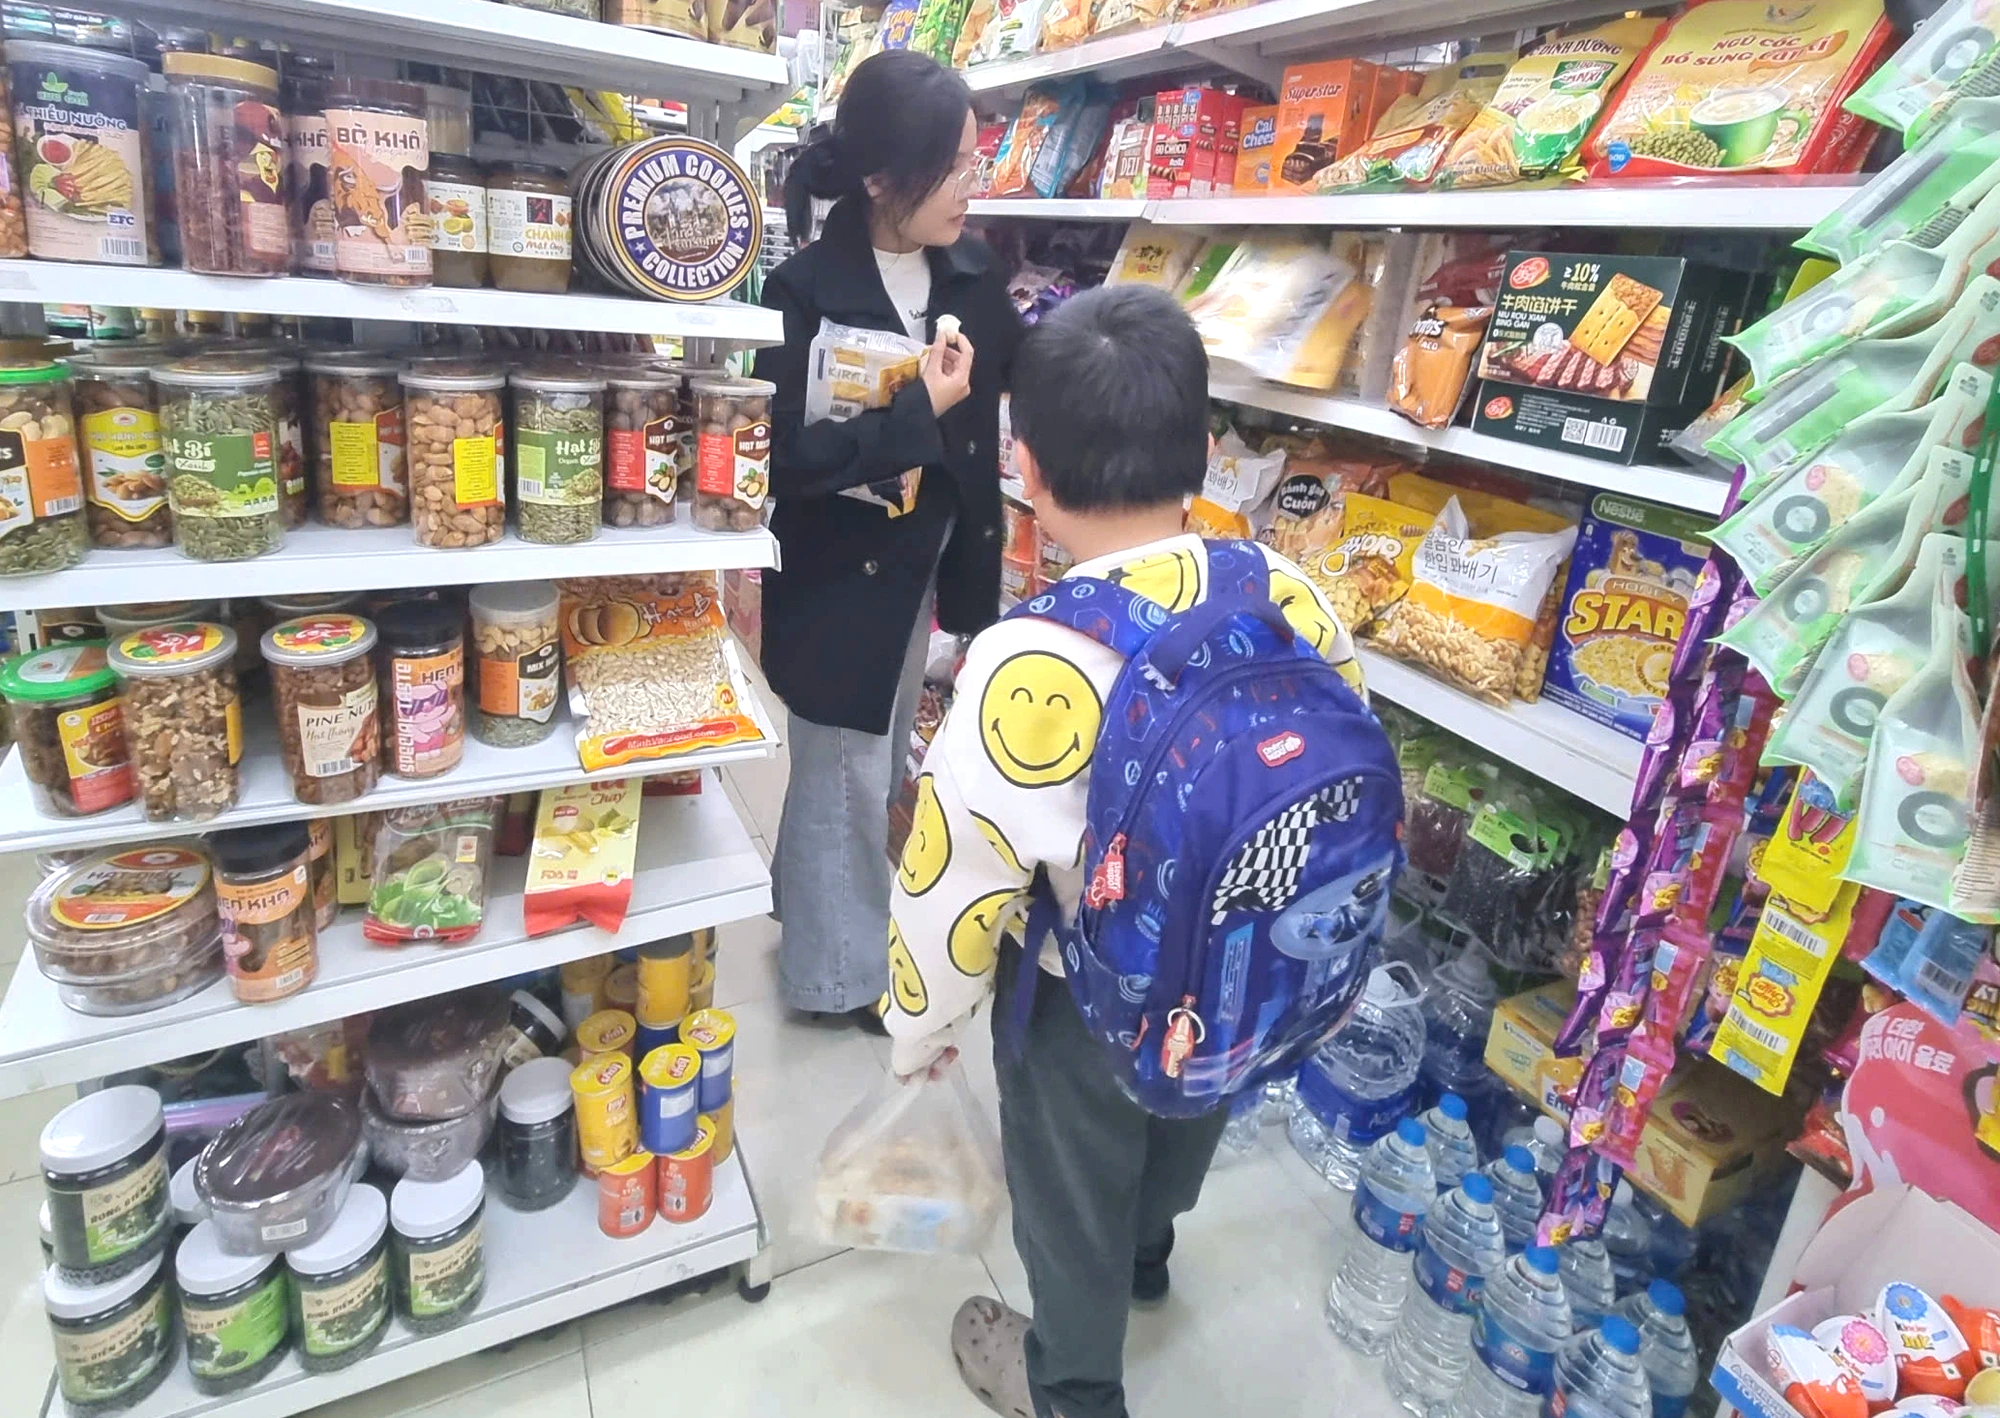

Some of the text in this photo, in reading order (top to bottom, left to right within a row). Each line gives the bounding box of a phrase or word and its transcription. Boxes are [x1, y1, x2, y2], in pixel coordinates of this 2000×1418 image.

[1538, 41, 1573, 55] DINH
[1693, 51, 1754, 66] SUNG
[1284, 83, 1343, 104] Superstar
[1255, 117, 1274, 133] Cal
[337, 122, 421, 150] BÒ KHÔ
[1242, 132, 1275, 149] Chees
[1120, 156, 1140, 176] DELI
[622, 154, 681, 241] PREMIUM
[685, 154, 749, 229] COOKIES
[107, 213, 135, 227] EFC
[641, 241, 746, 288] COLLECTION
[1501, 294, 1578, 316] 牛肉馅饼干
[555, 438, 586, 457] Hạt
[1567, 591, 1687, 642] STAR
[306, 712, 344, 728] PINE
